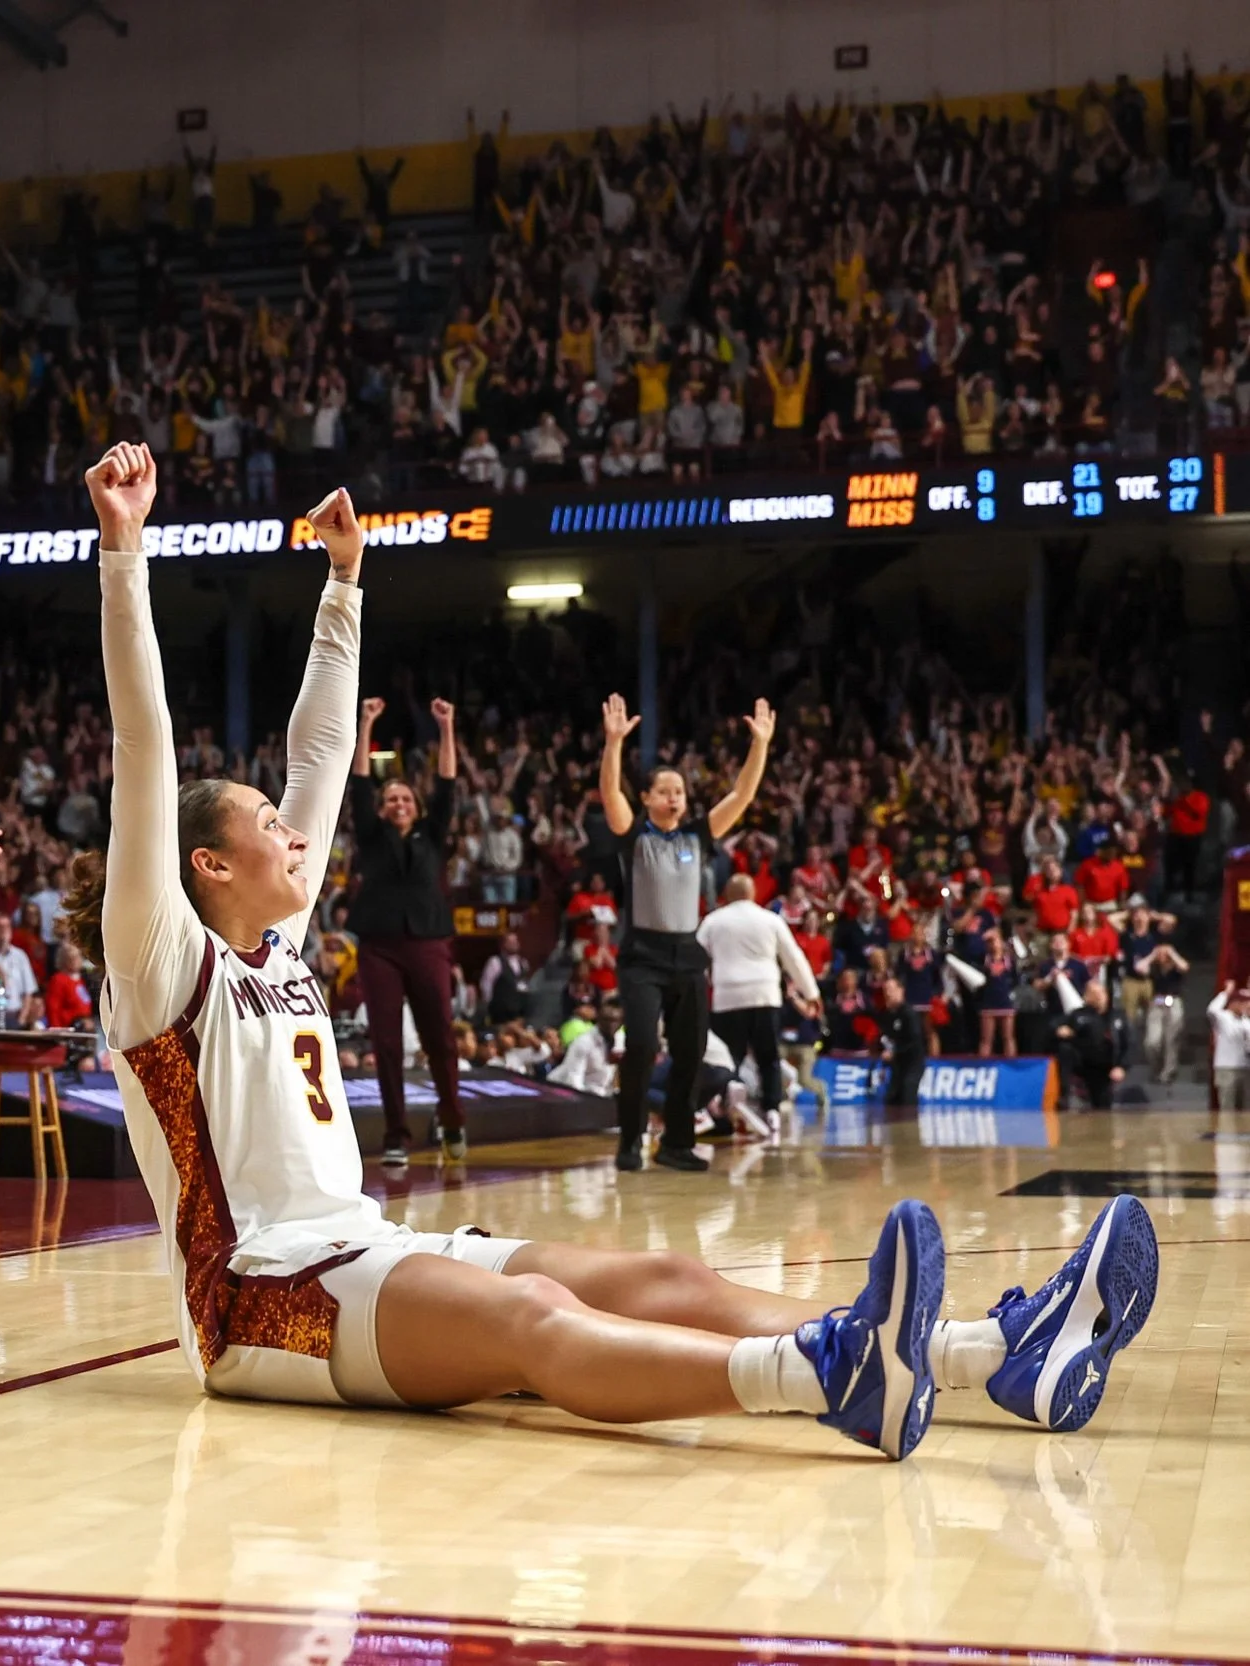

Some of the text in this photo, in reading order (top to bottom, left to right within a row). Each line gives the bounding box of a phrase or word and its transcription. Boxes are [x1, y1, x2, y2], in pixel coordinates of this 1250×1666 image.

[976, 468, 995, 494] 9
[1072, 462, 1100, 488] 21
[1168, 457, 1202, 482] 30
[847, 472, 918, 500] MINN
[928, 485, 972, 511] OFF.
[1022, 480, 1068, 506] DEF.
[1115, 475, 1161, 501] TOT.
[1169, 486, 1199, 512] 27
[729, 494, 834, 523] REBOUNDS
[847, 500, 915, 528] MISS
[1072, 491, 1102, 517] 19
[141, 518, 284, 558] SECOND
[291, 511, 449, 550] RNDS
[293, 1030, 333, 1125] 3
[918, 1066, 999, 1100] ARCH
